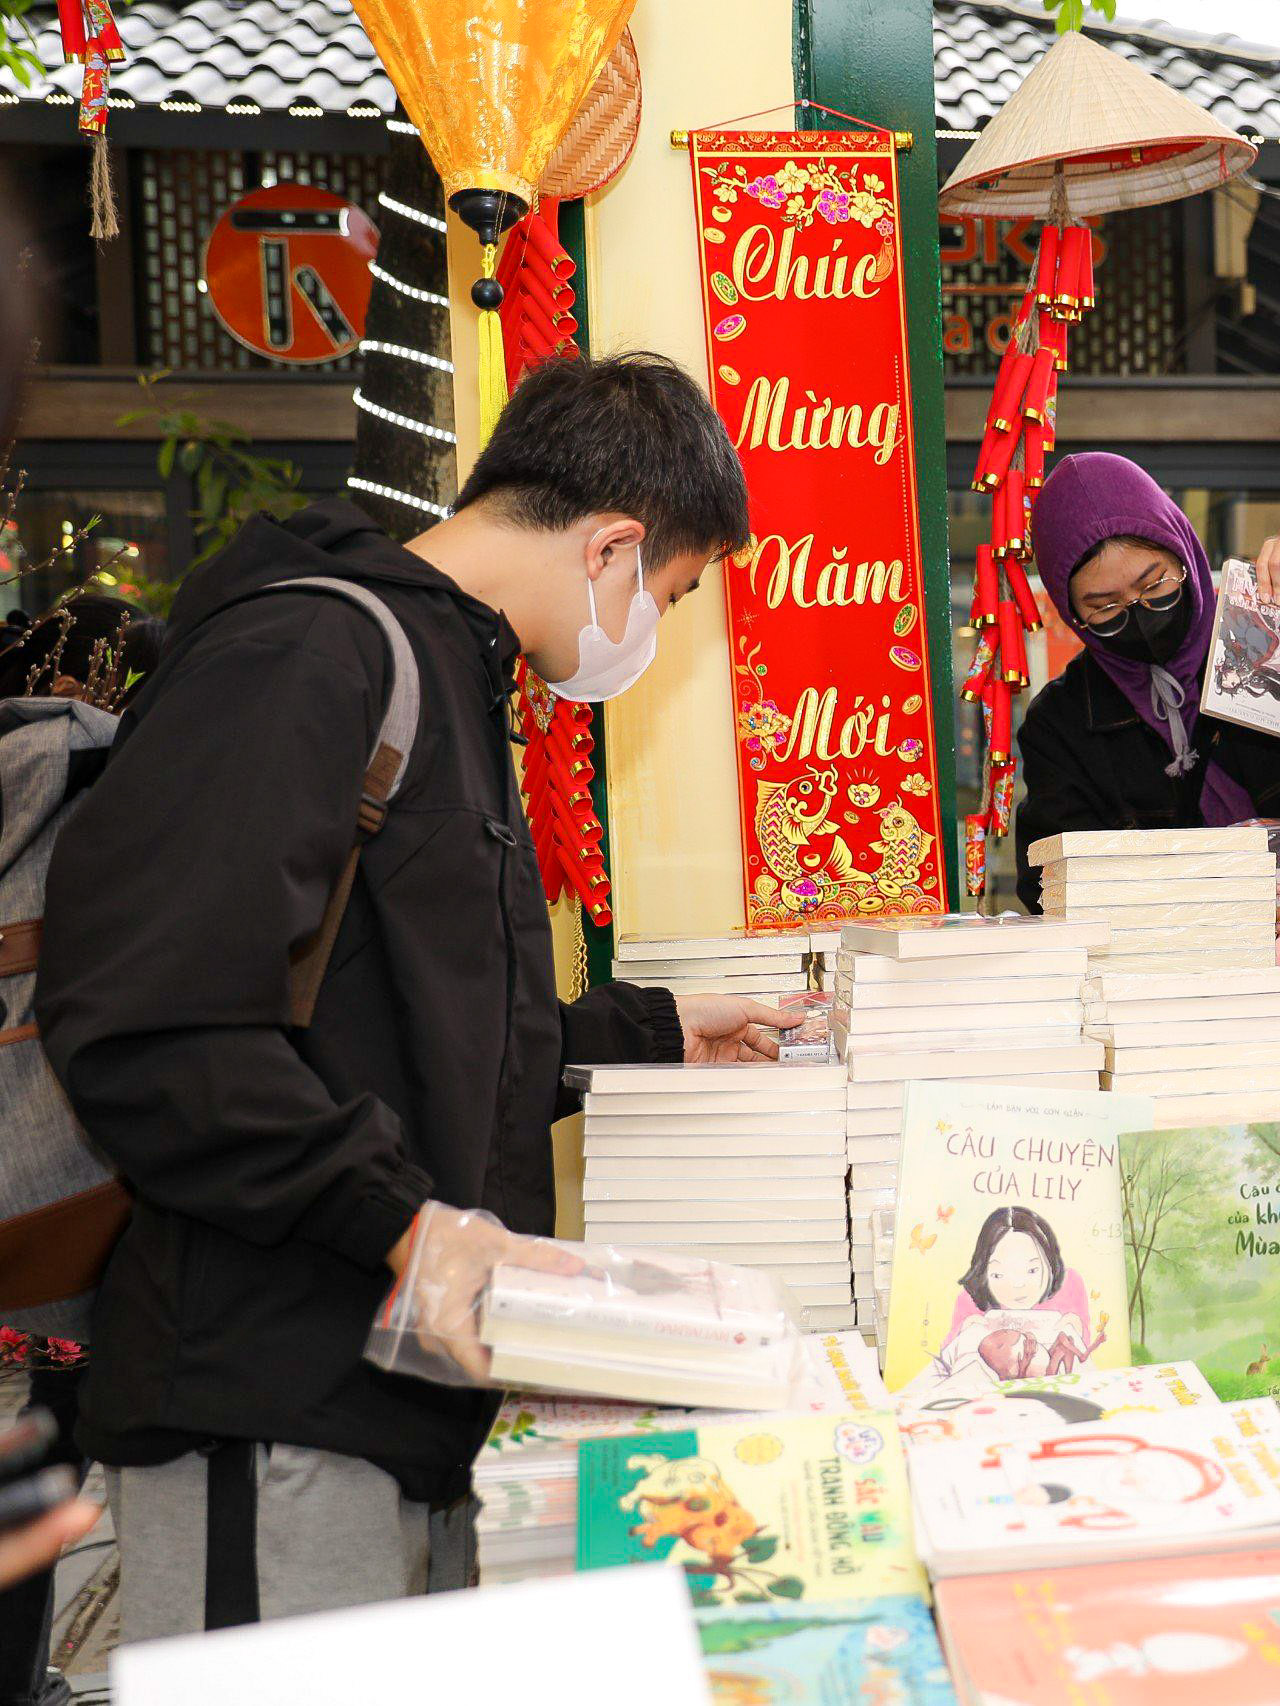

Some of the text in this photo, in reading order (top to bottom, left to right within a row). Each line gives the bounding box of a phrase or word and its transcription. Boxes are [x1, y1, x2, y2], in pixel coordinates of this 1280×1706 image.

[732, 224, 880, 301] Chúc
[734, 376, 905, 465] Mừng
[750, 534, 911, 609] Năm
[772, 686, 901, 762] Mới
[946, 1126, 1115, 1172] CÂU CHUYỆN
[973, 1165, 1082, 1201] CỦA LILY
[1240, 1183, 1270, 1200] Câu
[1228, 1210, 1249, 1225] của
[1235, 1230, 1280, 1258] Mùa
